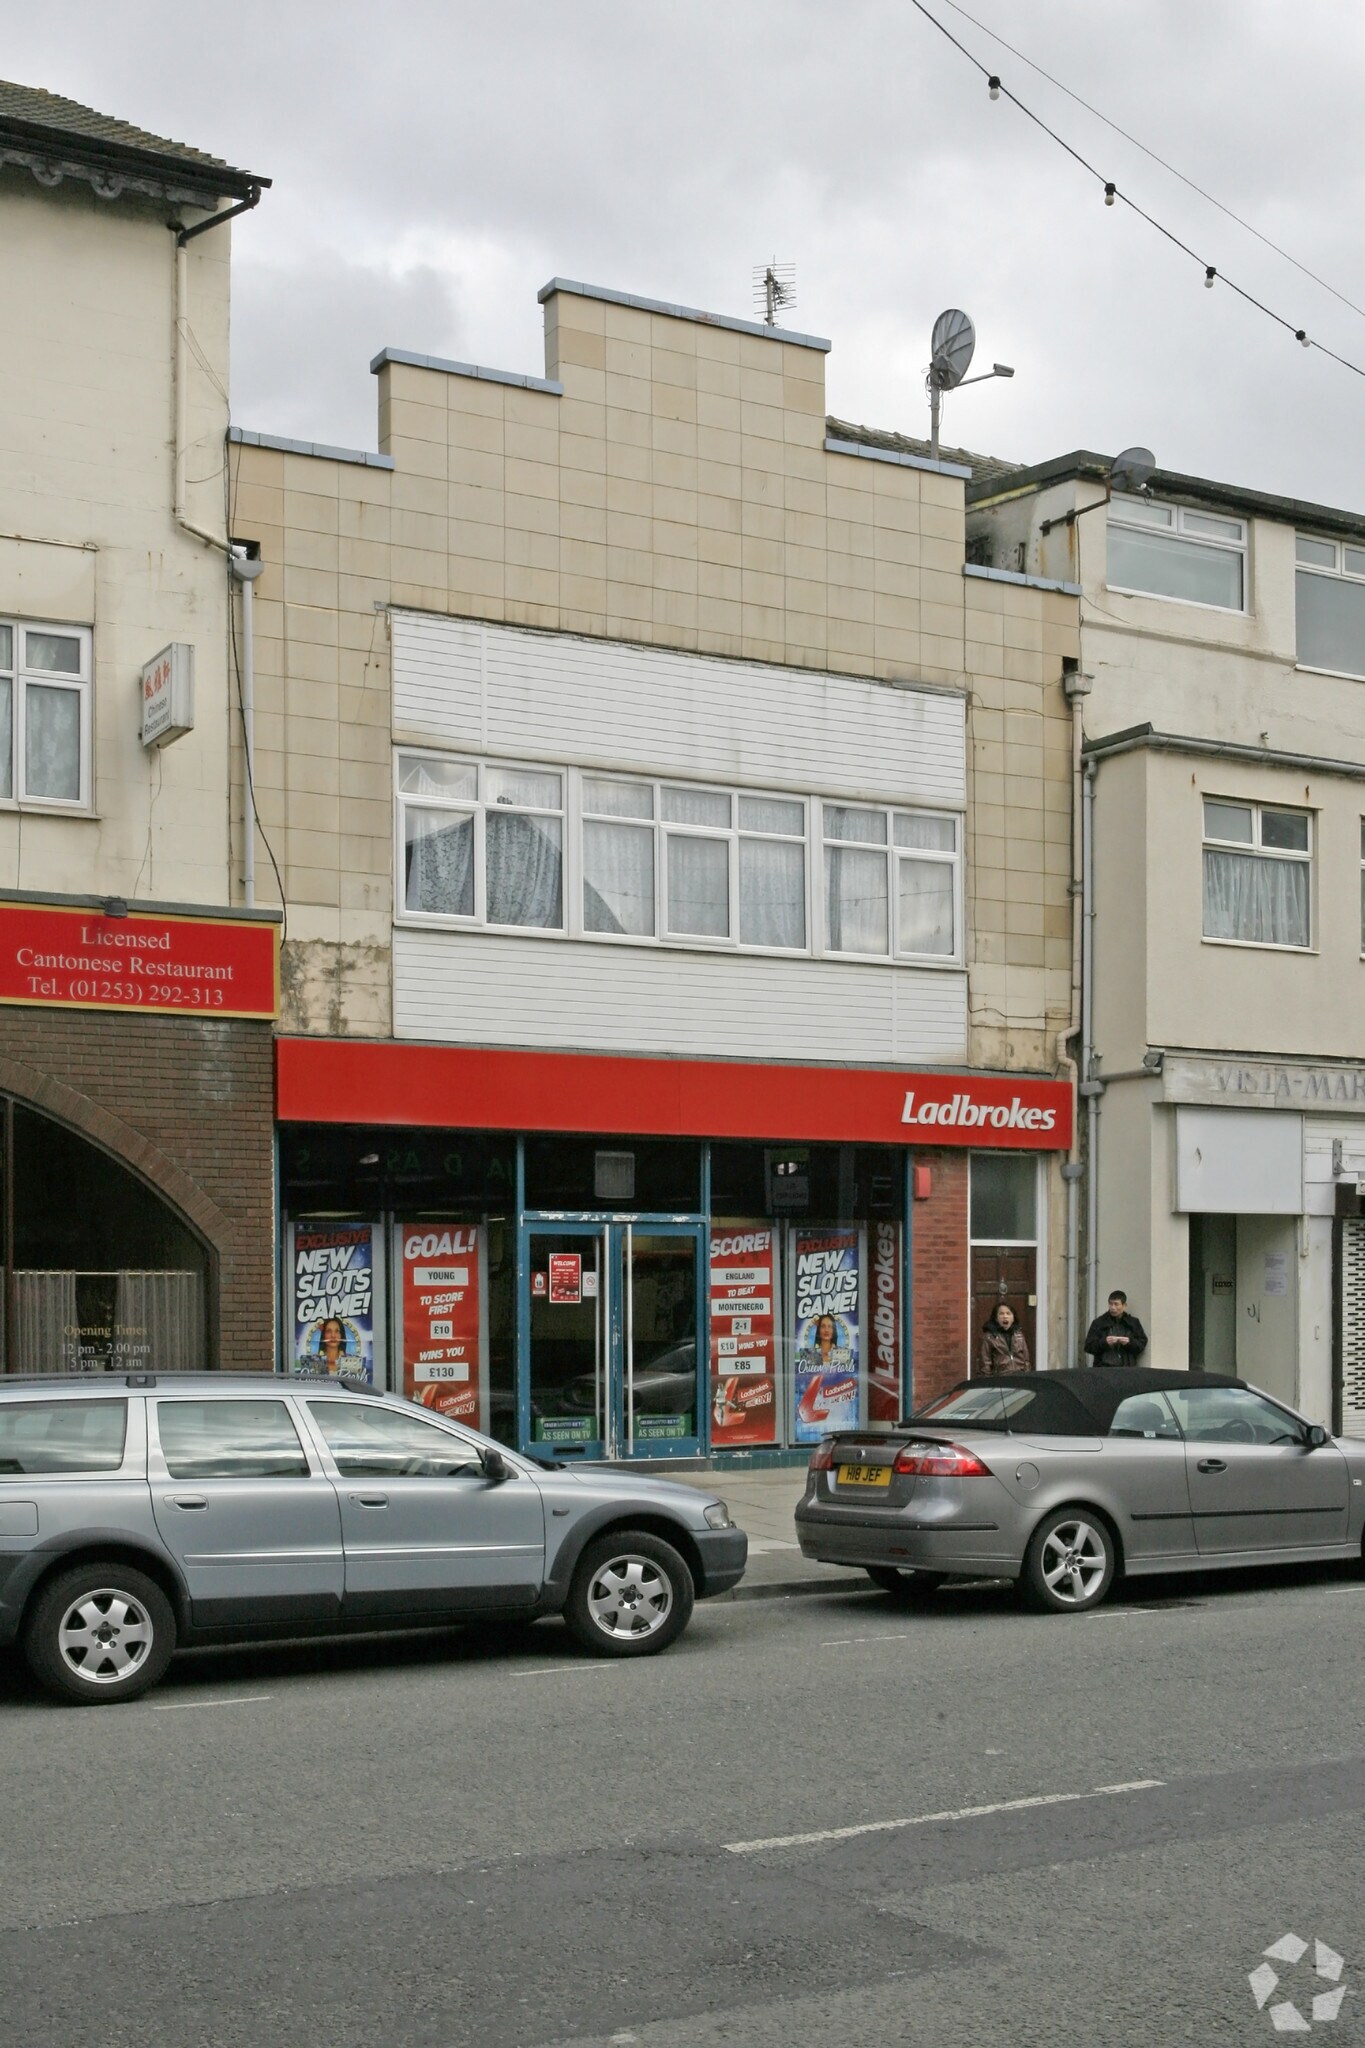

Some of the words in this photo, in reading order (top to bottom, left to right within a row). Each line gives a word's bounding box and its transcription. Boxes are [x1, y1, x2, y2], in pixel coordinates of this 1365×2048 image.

[80, 926, 171, 950] Licensed
[16, 948, 123, 973] Cantonese
[129, 957, 234, 980] Restaurant
[27, 976, 63, 995] Tel.
[69, 980, 143, 1004] (01253)
[149, 985, 224, 1005] 292-313
[901, 1091, 1057, 1130] Ladbrokes
[296, 1228, 370, 1250] EXCLUSIVE
[404, 1228, 477, 1260] GOAL!
[710, 1231, 771, 1258] SCORE!
[296, 1245, 355, 1275] NEW
[797, 1249, 845, 1276] NEW
[428, 1271, 455, 1280] YOUNG
[725, 1272, 755, 1280] ENGLAND
[797, 1269, 858, 1297] SLOTS
[296, 1268, 372, 1299] SLOTS
[420, 1295, 433, 1306] TO
[433, 1291, 464, 1304] SCORE
[727, 1289, 737, 1298] TO
[737, 1286, 755, 1296] BEAT
[297, 1292, 371, 1323] GAME!
[718, 1302, 764, 1311] MONTENEGRO
[797, 1290, 858, 1319] GAME!
[874, 1222, 895, 1379] Ladbrokes
[428, 1303, 455, 1316] FIRST
[64, 1325, 112, 1338] Opening
[114, 1325, 148, 1336] Times
[434, 1325, 450, 1334] £10
[735, 1321, 747, 1330] 2-1
[62, 1344, 74, 1355] 12
[77, 1347, 95, 1356] pm
[106, 1343, 131, 1354] 2.00
[133, 1345, 151, 1355] pm
[720, 1342, 735, 1351] £10
[738, 1341, 754, 1351] WINS
[755, 1339, 768, 1347] YOU
[420, 1349, 444, 1361] WINS
[446, 1346, 465, 1358] YOU
[70, 1357, 77, 1368] 5
[80, 1360, 98, 1370] pm
[110, 1357, 123, 1367] 12
[125, 1359, 142, 1367] am
[734, 1361, 751, 1370] £85
[429, 1367, 454, 1377] £130
[740, 1383, 769, 1399] Ladbrokes
[825, 1381, 853, 1396] Ladbrokes
[439, 1390, 472, 1408] Ladbrokes
[542, 1431, 551, 1440] AS
[552, 1430, 570, 1440] SEEN
[571, 1430, 580, 1439] ON
[581, 1430, 591, 1439] TV
[638, 1428, 647, 1438] AS
[648, 1428, 665, 1438] SEEN
[665, 1428, 676, 1437] ON
[676, 1427, 686, 1437] TV
[846, 1466, 861, 1481] H18
[862, 1467, 883, 1482] JEF
